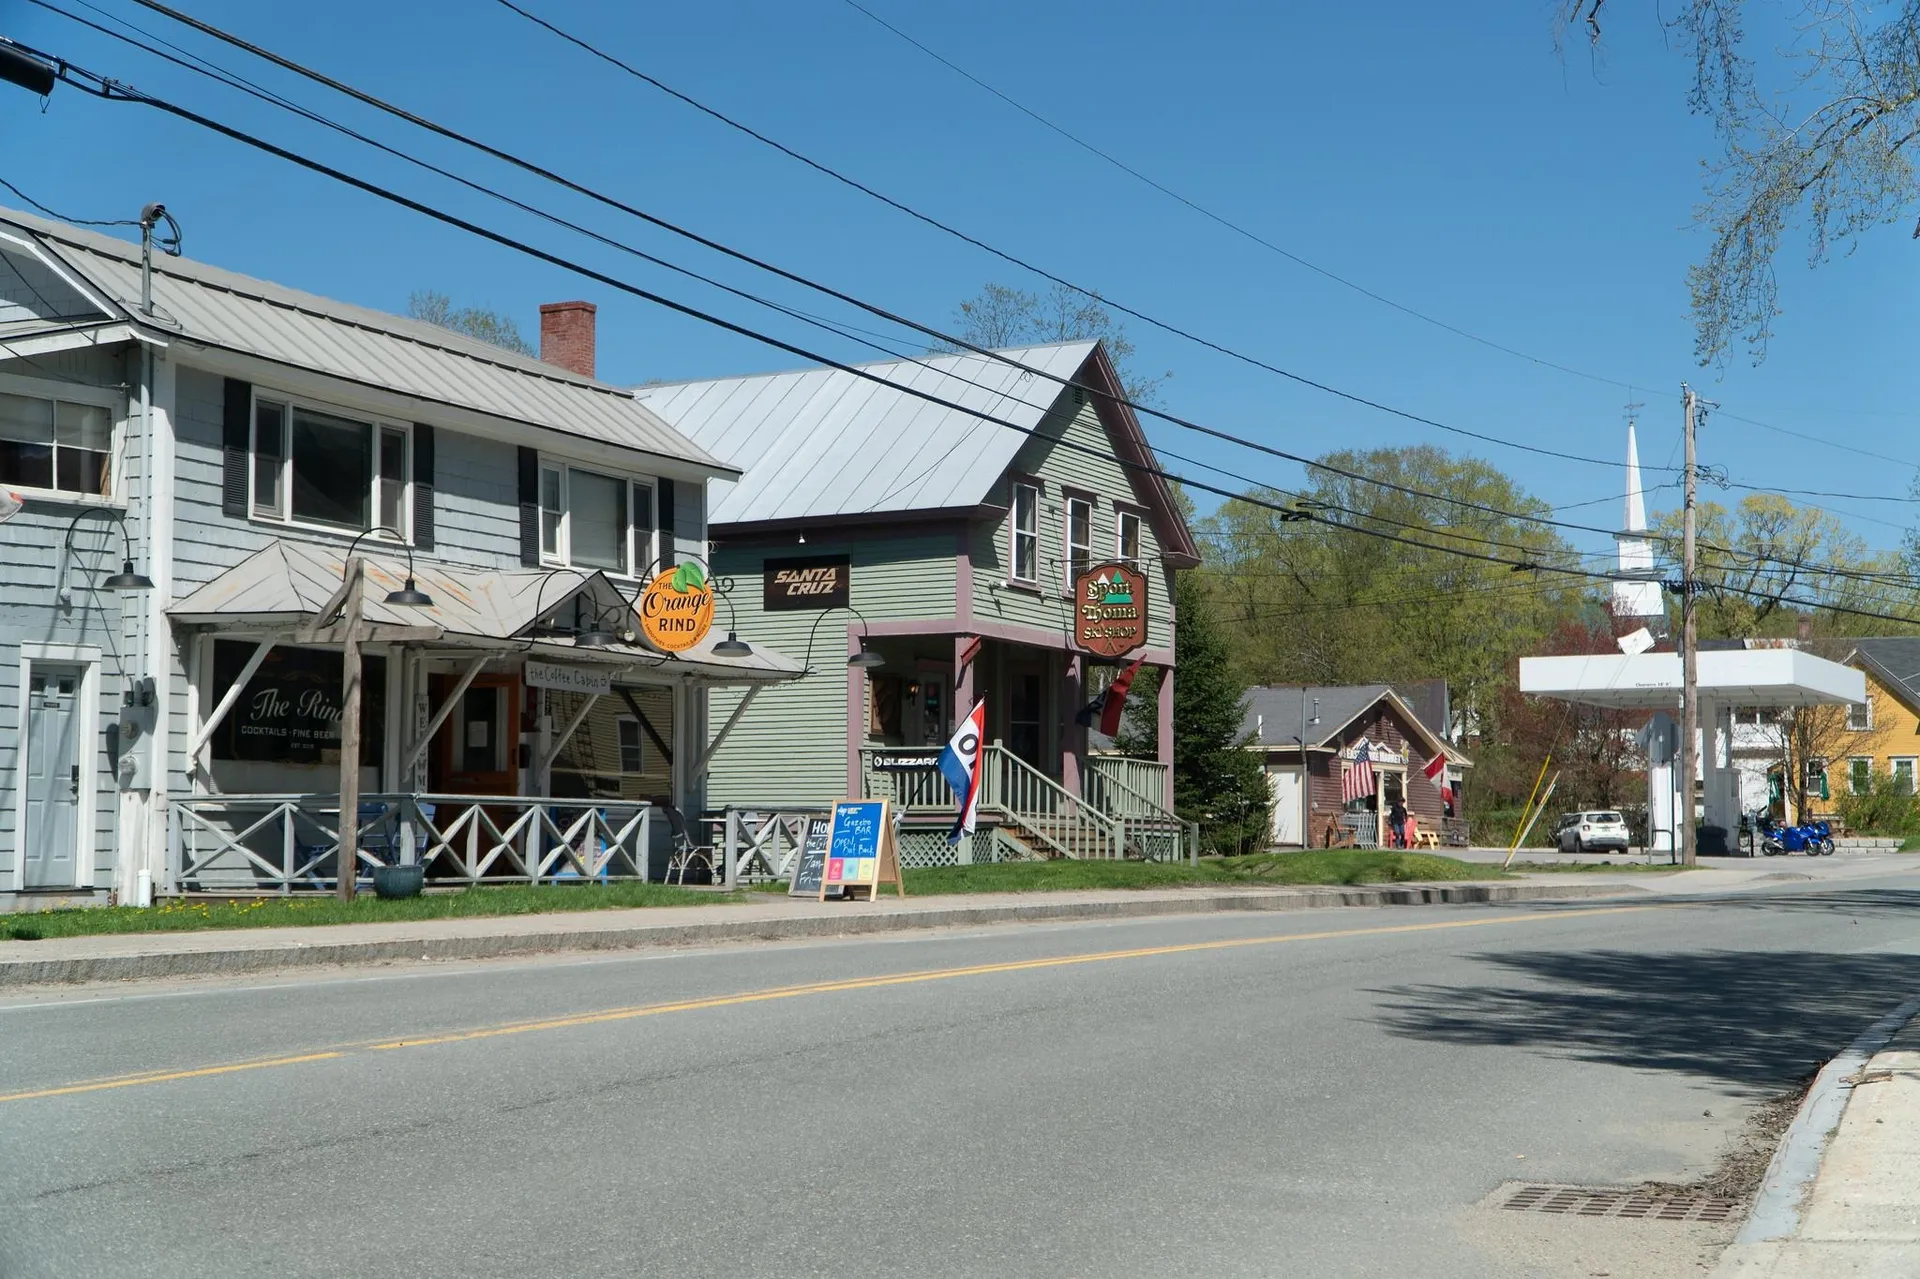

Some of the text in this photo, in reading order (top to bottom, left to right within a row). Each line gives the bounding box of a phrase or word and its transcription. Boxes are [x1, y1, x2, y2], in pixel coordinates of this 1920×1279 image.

[774, 567, 837, 584] SANTA
[786, 581, 837, 596] CRUZ
[1087, 580, 1132, 600] Sport
[643, 592, 710, 618] Orange
[1081, 602, 1137, 623] Thoma
[659, 618, 696, 632] RIND
[1084, 626, 1137, 639] SKI SHOP
[530, 666, 599, 688] the Coffee Cabin
[250, 688, 290, 720] The
[241, 725, 287, 737] COCKTAILS
[292, 728, 311, 739] FINE
[844, 816, 872, 829] Gazebo
[855, 826, 872, 835] BAR
[858, 844, 875, 857] Back
